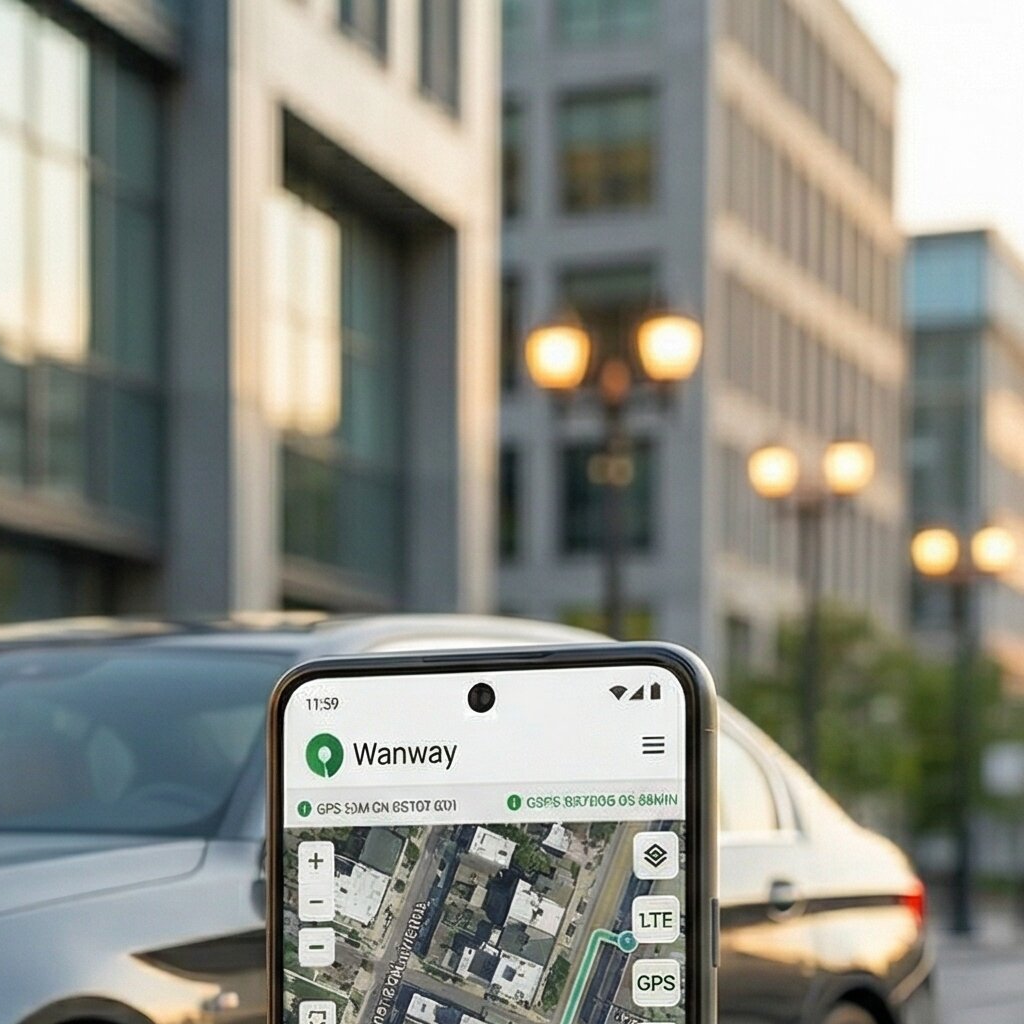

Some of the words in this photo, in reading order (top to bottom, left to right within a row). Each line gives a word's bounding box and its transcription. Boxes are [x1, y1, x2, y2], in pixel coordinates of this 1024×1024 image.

[306, 697, 339, 711] 11:59
[353, 742, 457, 770] Wanway
[317, 802, 341, 815] GPS
[637, 975, 676, 991] GPS
